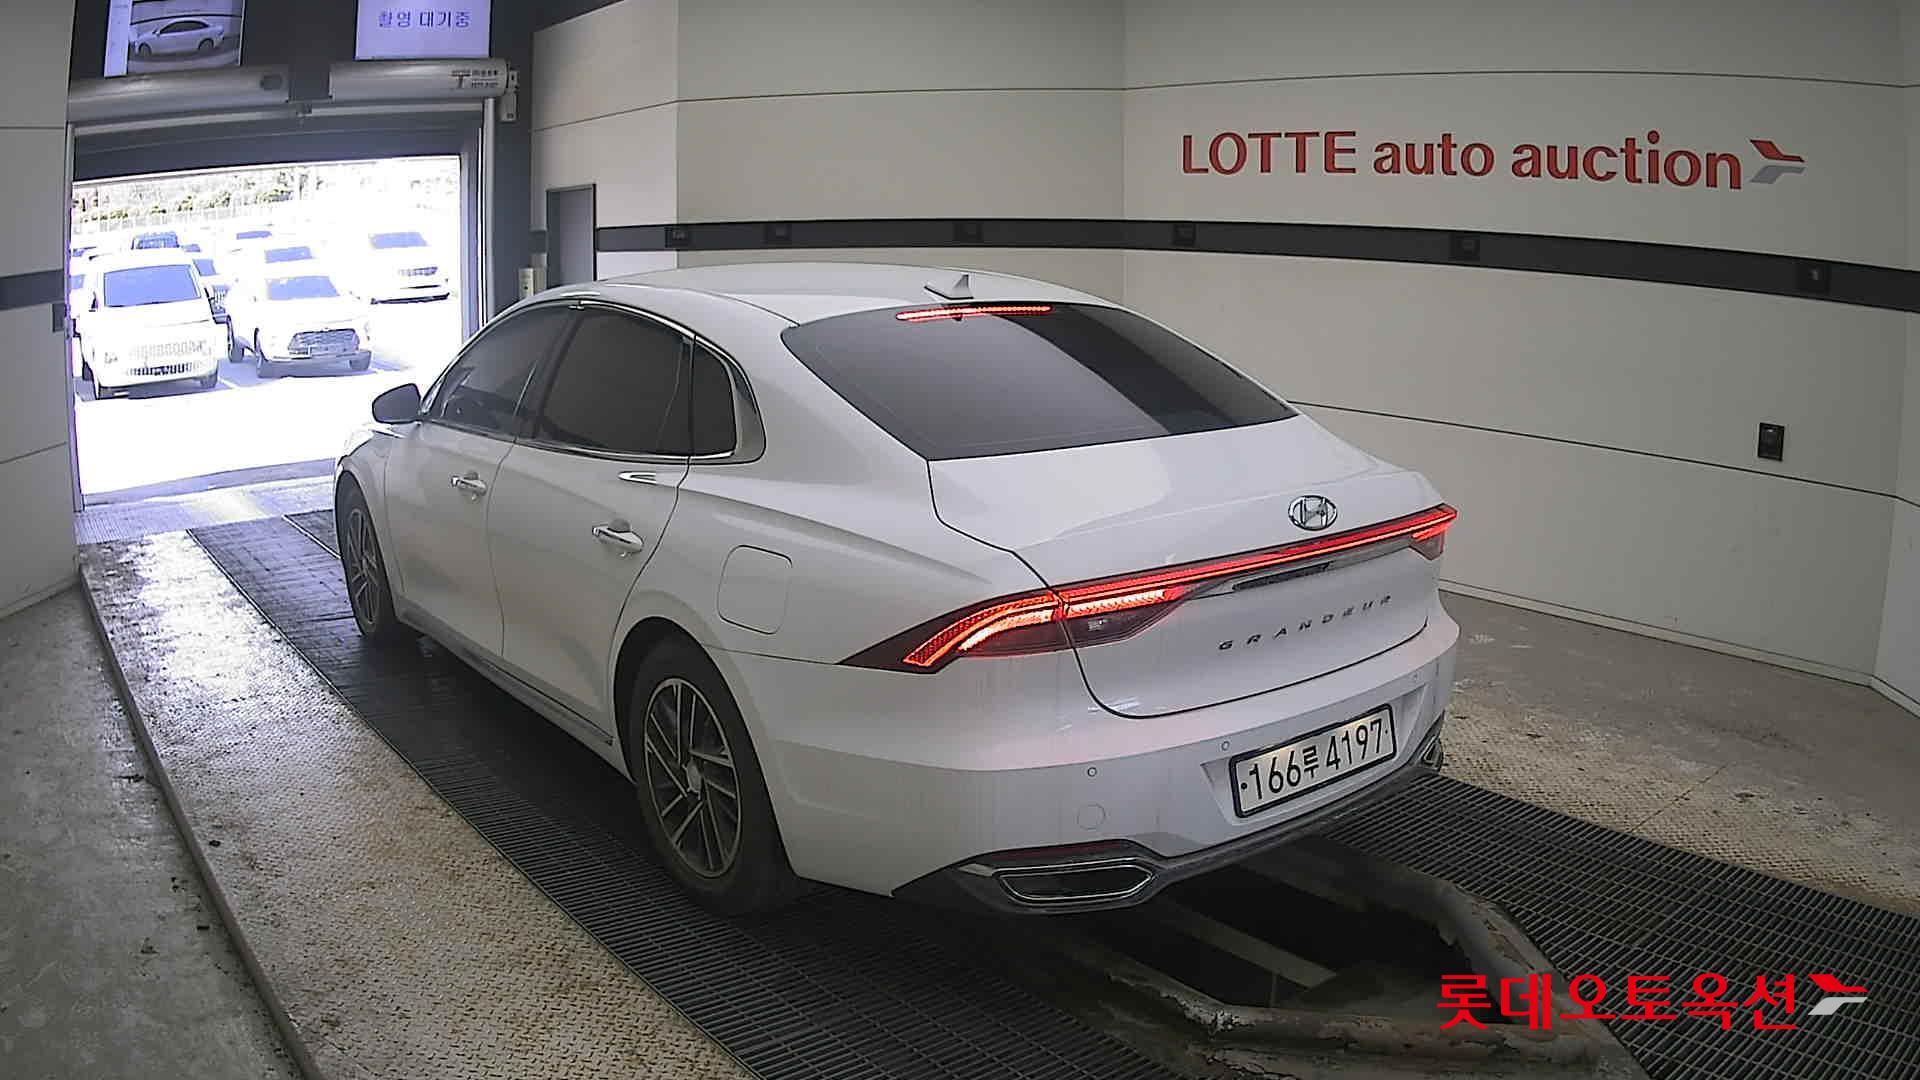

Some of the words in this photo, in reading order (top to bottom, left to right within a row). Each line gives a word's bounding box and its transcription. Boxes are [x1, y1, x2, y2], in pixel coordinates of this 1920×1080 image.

[419, 10, 471, 28] 대기중
[1183, 131, 1357, 176] LOTTE
[1373, 134, 1495, 178] auto
[1511, 131, 1742, 190] auction
[1218, 595, 1391, 651] GRANDEUR
